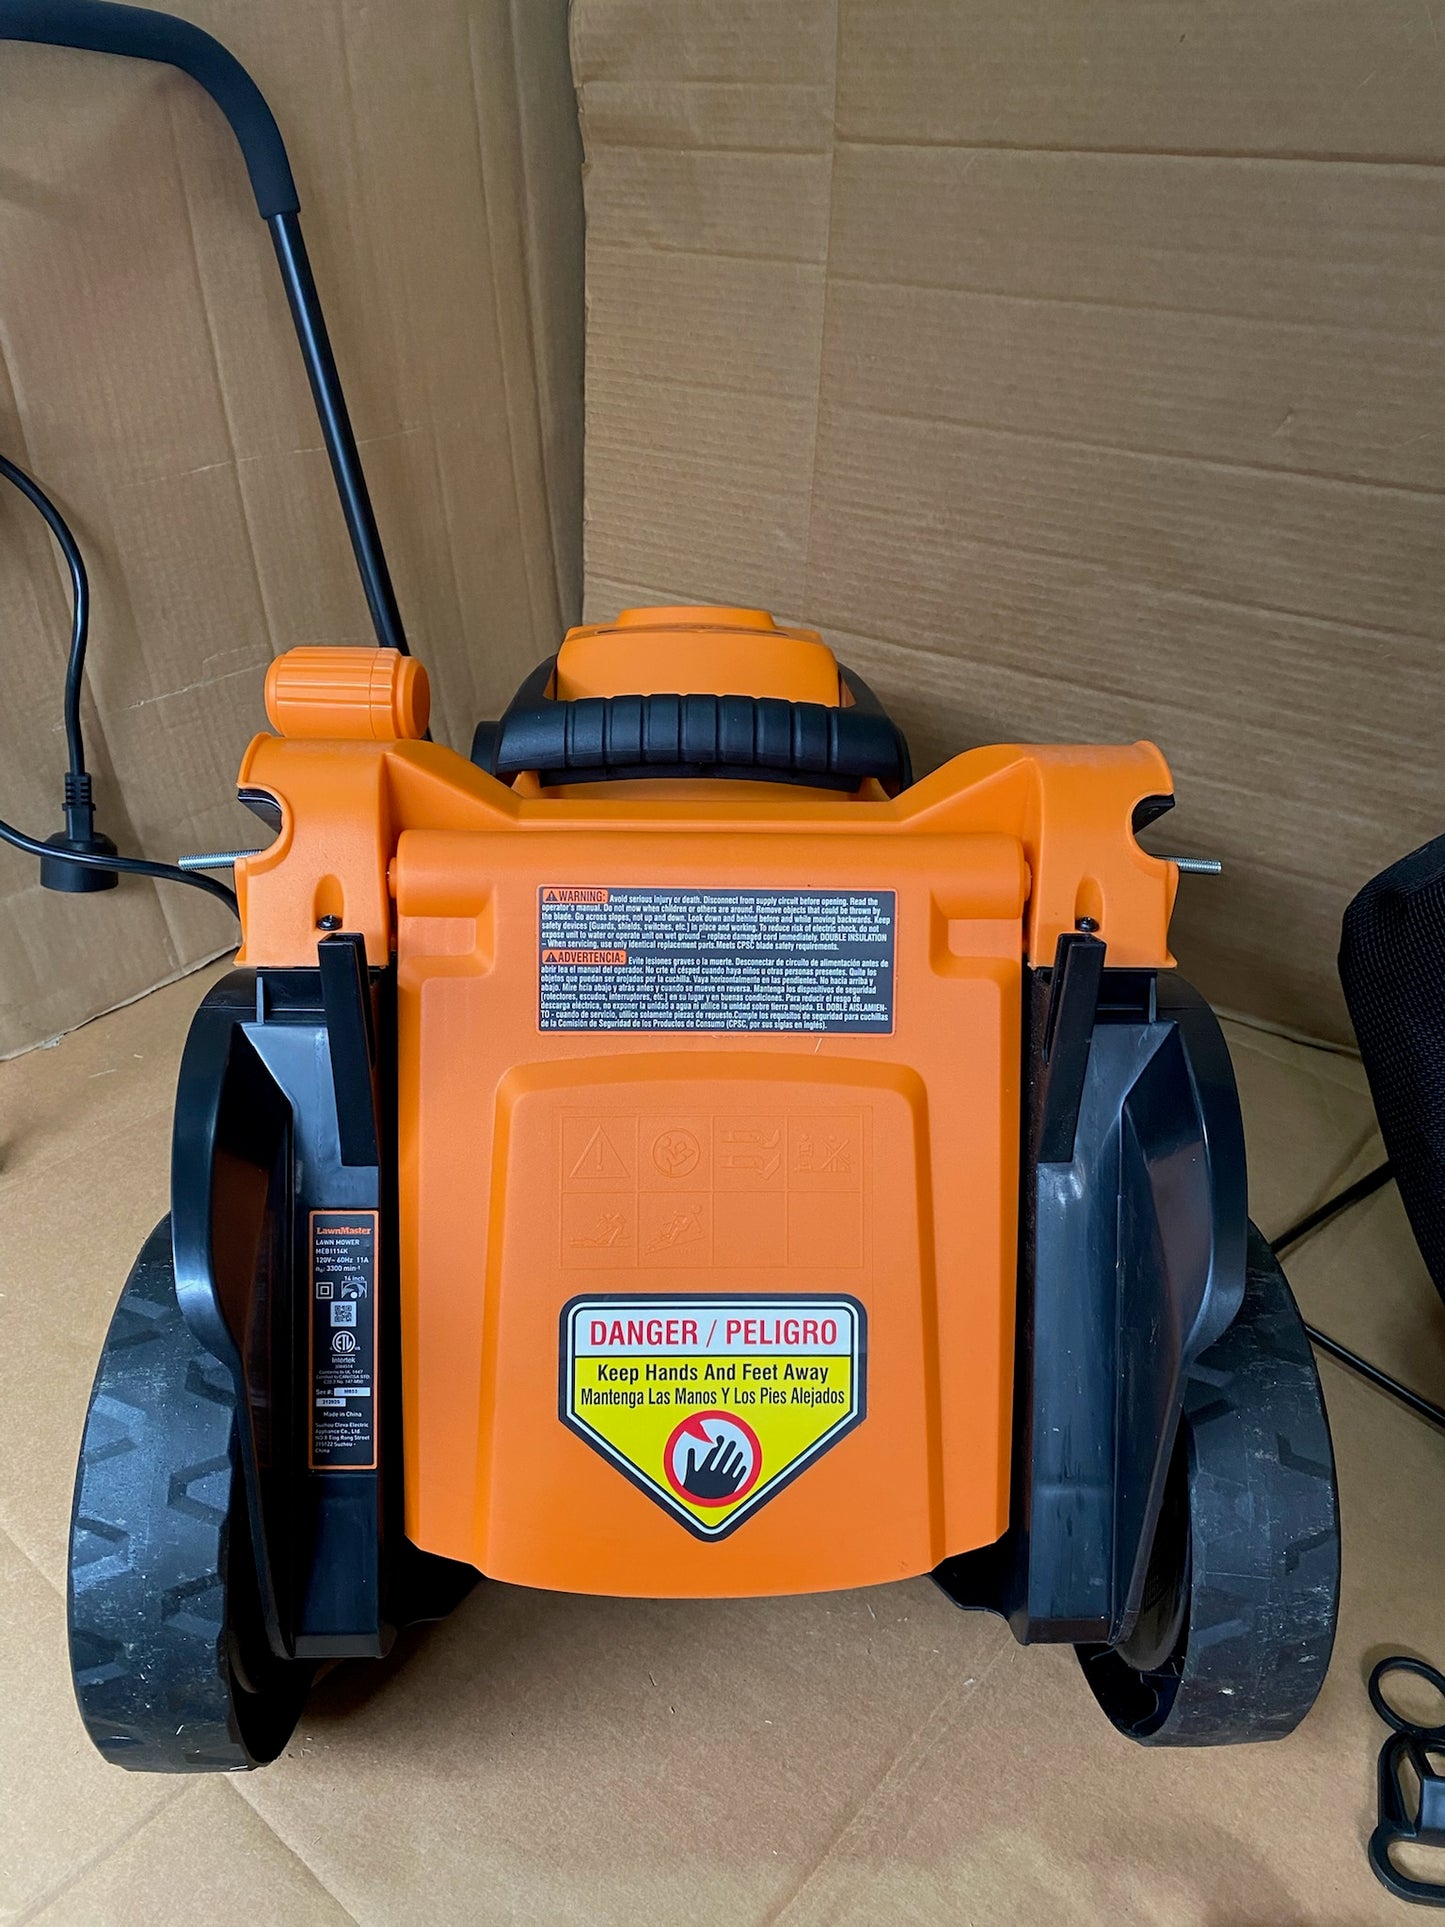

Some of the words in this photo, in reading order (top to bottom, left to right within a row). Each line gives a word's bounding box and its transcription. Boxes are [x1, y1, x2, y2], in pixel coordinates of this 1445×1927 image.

[559, 891, 605, 901] WARNING:
[654, 896, 672, 905] injury
[756, 897, 777, 906] supply
[542, 904, 575, 913] operator's
[783, 906, 806, 915] objects
[872, 907, 880, 916] by
[644, 915, 653, 923] up
[813, 915, 836, 924] moving
[874, 916, 890, 925] Keep
[542, 922, 561, 932] safety
[699, 924, 716, 933] place
[542, 932, 565, 940] expose
[616, 932, 640, 941] operate
[678, 932, 700, 941] ground
[707, 933, 731, 942] replace
[732, 933, 762, 942] damaged
[614, 941, 627, 950] only
[657, 941, 697, 950] replacement
[775, 942, 794, 951] safety
[558, 952, 624, 963] ADVERTENCIA:
[673, 958, 695, 966] graves
[590, 1319, 698, 1345] DANGER
[706, 1319, 717, 1347] /
[726, 1319, 837, 1345] PELIGRO
[598, 1364, 639, 1385] Keep
[646, 1364, 698, 1381] Hands
[704, 1364, 736, 1381] And
[742, 1364, 778, 1381] Feet
[783, 1364, 829, 1384] Away
[581, 1388, 644, 1408] Mantenga
[649, 1388, 670, 1405] Las
[675, 1388, 717, 1405] Manos
[722, 1388, 730, 1405] Y
[734, 1388, 756, 1405] Los
[760, 1388, 787, 1405] Pies
[791, 1388, 845, 1408] Alejados
